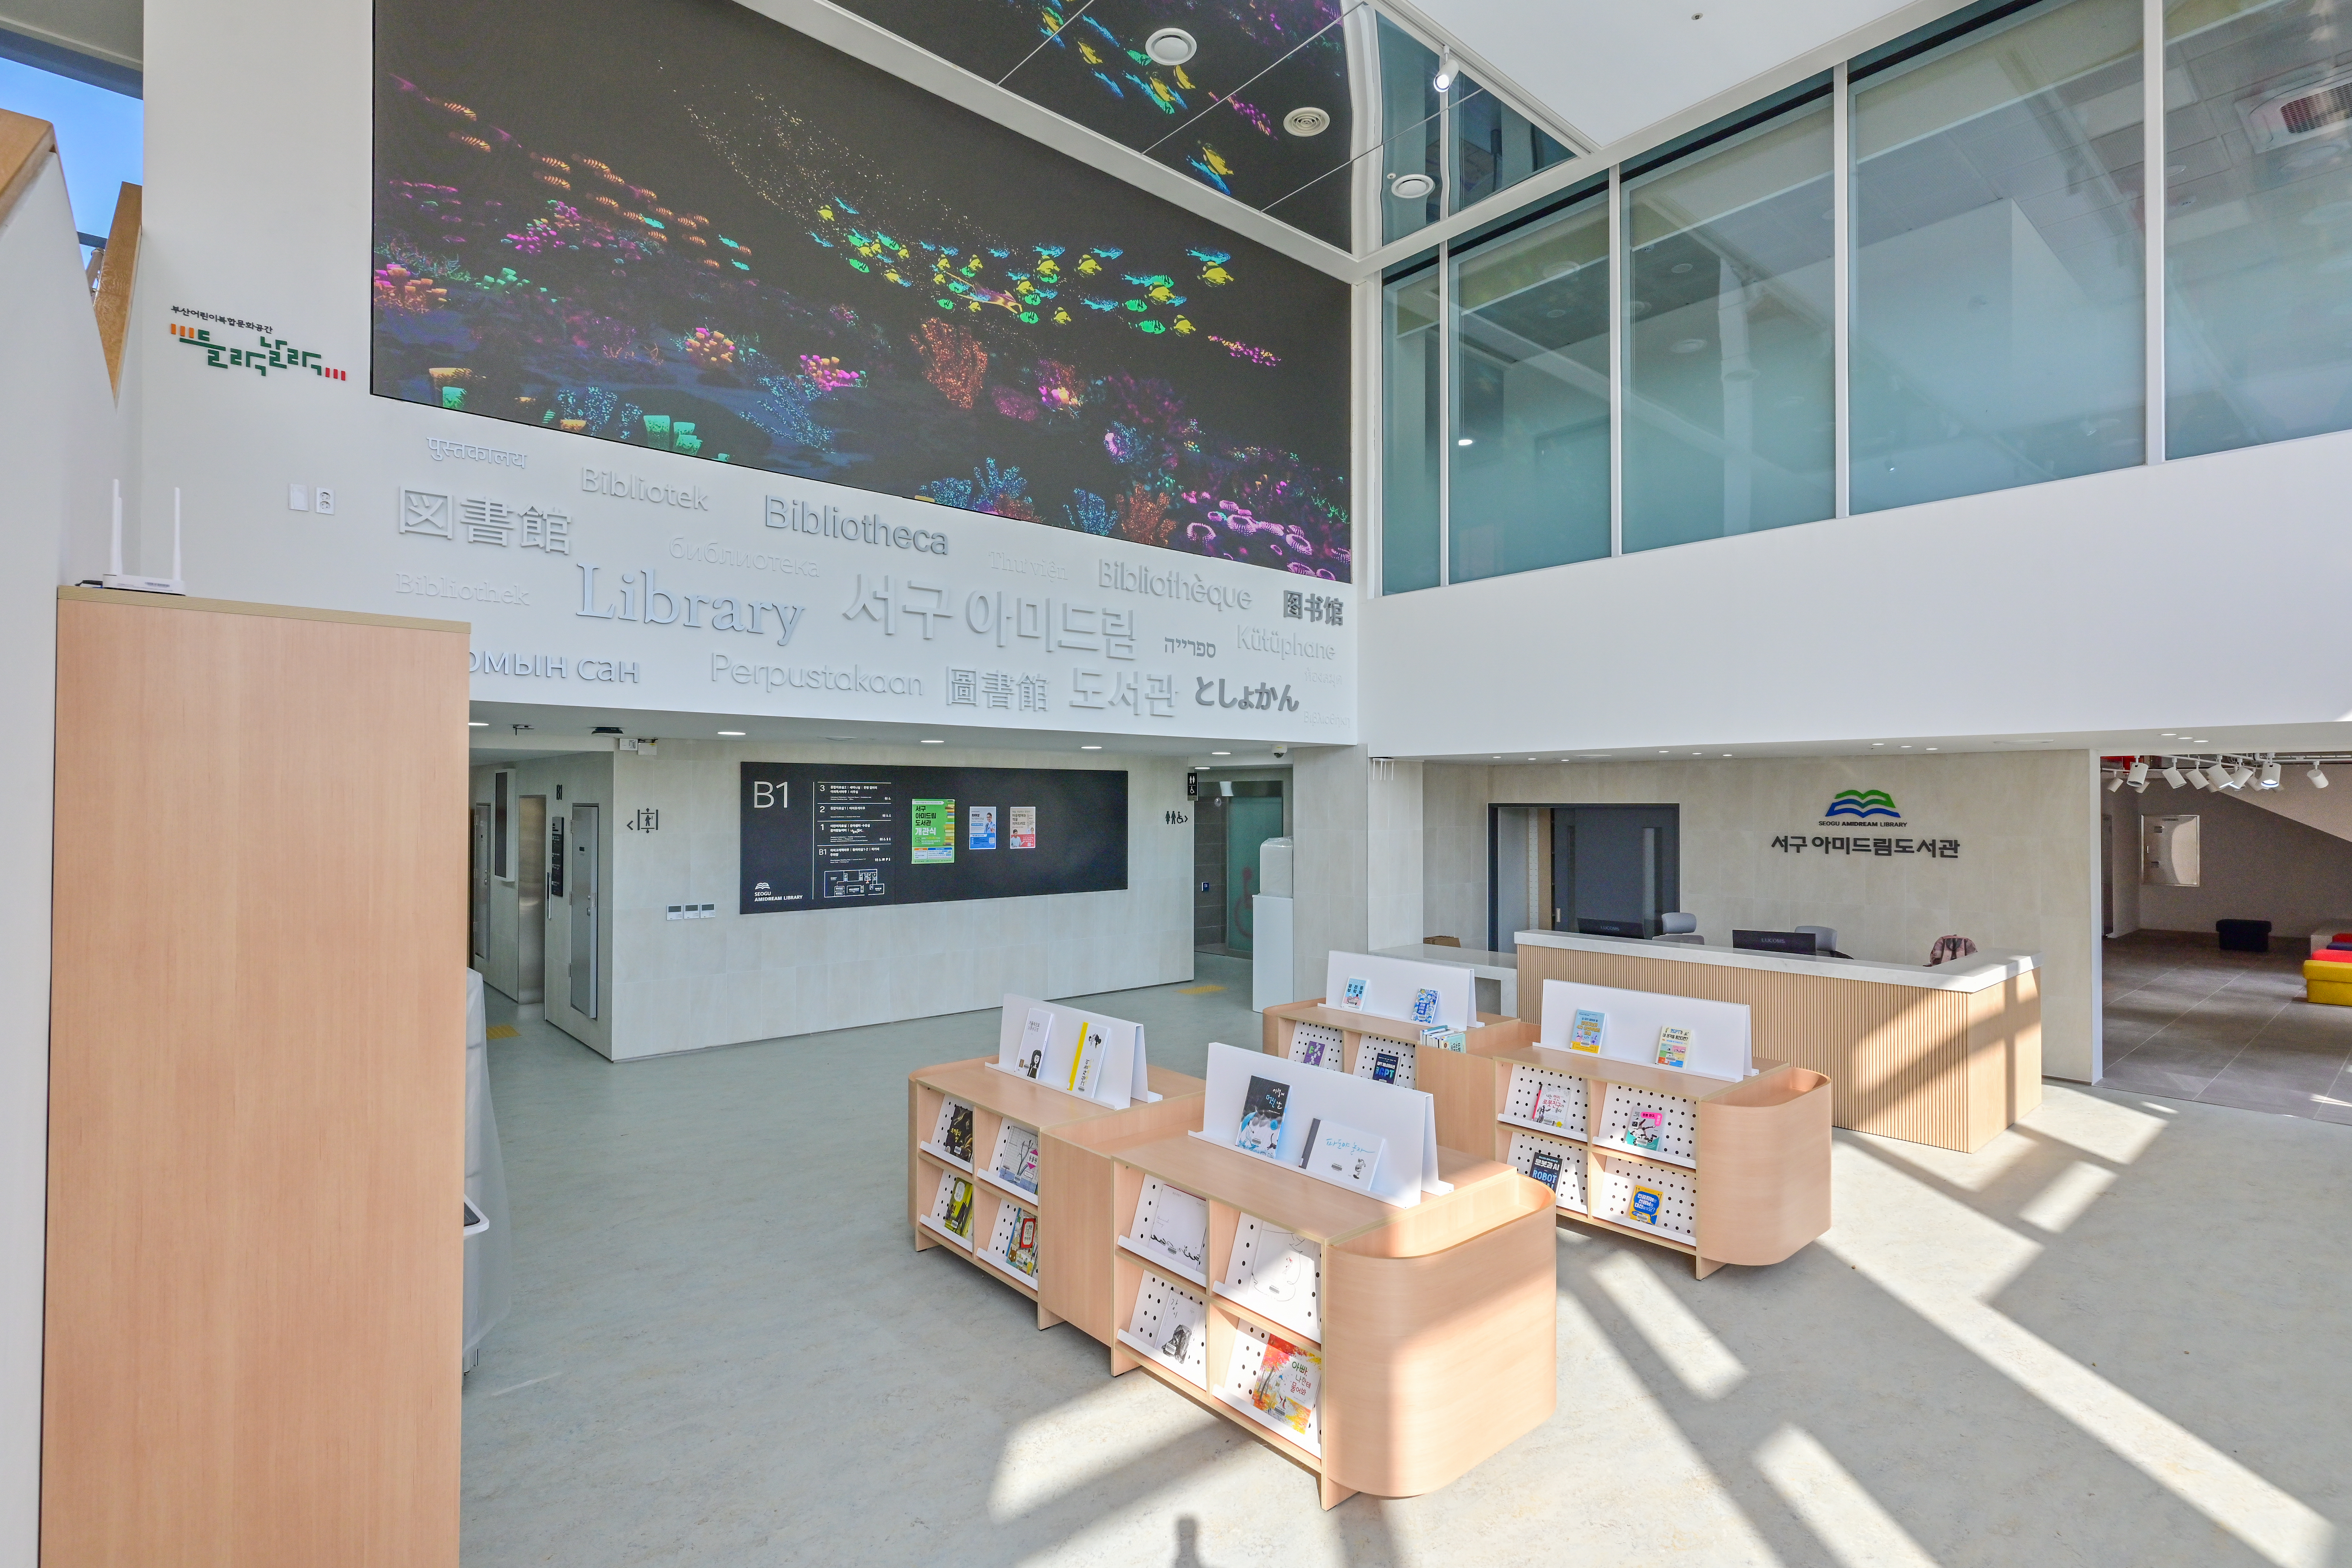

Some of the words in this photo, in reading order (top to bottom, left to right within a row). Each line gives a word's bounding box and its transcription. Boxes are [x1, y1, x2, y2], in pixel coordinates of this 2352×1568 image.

[171, 305, 273, 334] 부산어린이복합문화공간
[426, 437, 526, 469] पुस्तकालय
[582, 466, 708, 511] Bibliotek
[399, 485, 571, 555] 図書館
[765, 494, 948, 555] Bibliotheca
[669, 536, 819, 577] библиотека
[395, 573, 530, 606] Bibliothek
[1099, 558, 1252, 611] Bibliothèque
[576, 562, 805, 646] Library
[842, 573, 954, 640] 서구
[965, 589, 1137, 661] 아미드림
[1283, 589, 1344, 626] 图书馆
[1165, 636, 1216, 658] ספרייה
[1236, 624, 1336, 660] Kütüphane
[469, 650, 567, 678] омын
[577, 658, 640, 683] сан
[711, 651, 924, 697] Perpustakaan
[945, 665, 1050, 711] 圖書館
[1069, 667, 1179, 717] 도서관
[1195, 676, 1299, 712] としょかん
[556, 784, 562, 800] B1
[754, 781, 788, 808] B1
[1771, 836, 1807, 853] 서구
[1812, 836, 1960, 858] 아미드림도서관
[1266, 1094, 1276, 1108] 멋진
[1272, 1088, 1285, 1097] 이렇게
[1029, 1155, 1038, 1164] 동물원
[1326, 1138, 1350, 1149] 파도야
[1351, 1142, 1375, 1155] 놀자
[1532, 1169, 1557, 1183] ROBOT
[1534, 1158, 1553, 1169] 로봇과
[1292, 1361, 1308, 1377] 아빠,
[1296, 1374, 1311, 1389] 나한테
[1290, 1381, 1306, 1396] 물어봐
